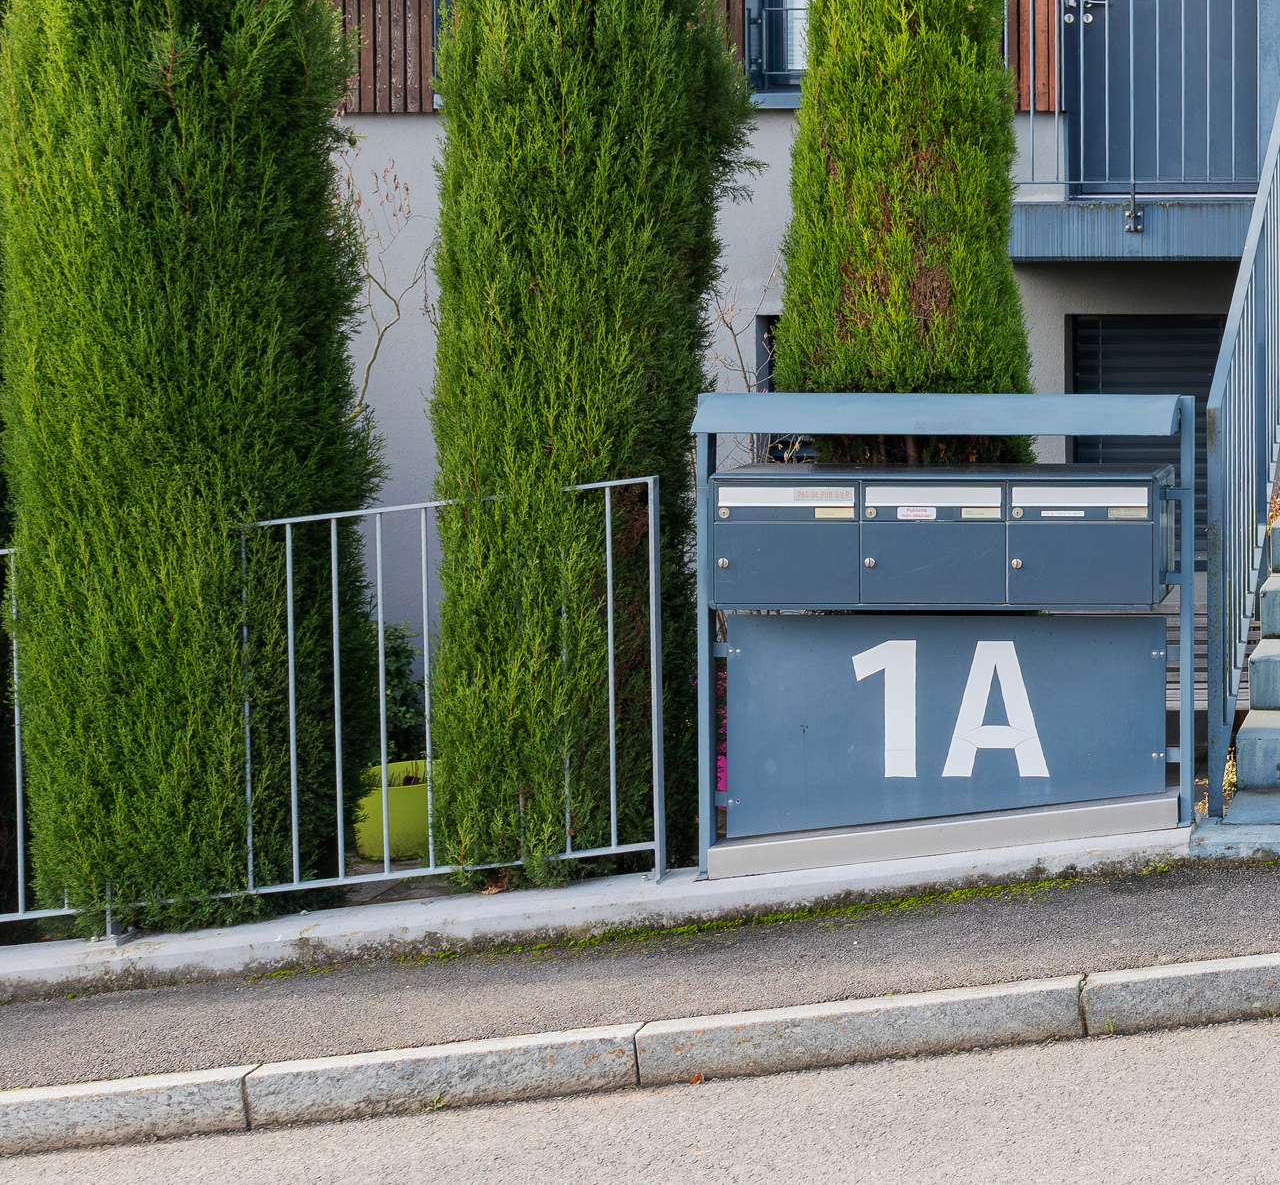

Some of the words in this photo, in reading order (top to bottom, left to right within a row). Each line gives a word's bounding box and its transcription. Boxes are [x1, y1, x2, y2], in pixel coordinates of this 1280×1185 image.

[797, 491, 809, 499] PAS
[810, 491, 819, 499] DE
[820, 491, 833, 499] PUB
[851, 640, 1050, 778] 1A
